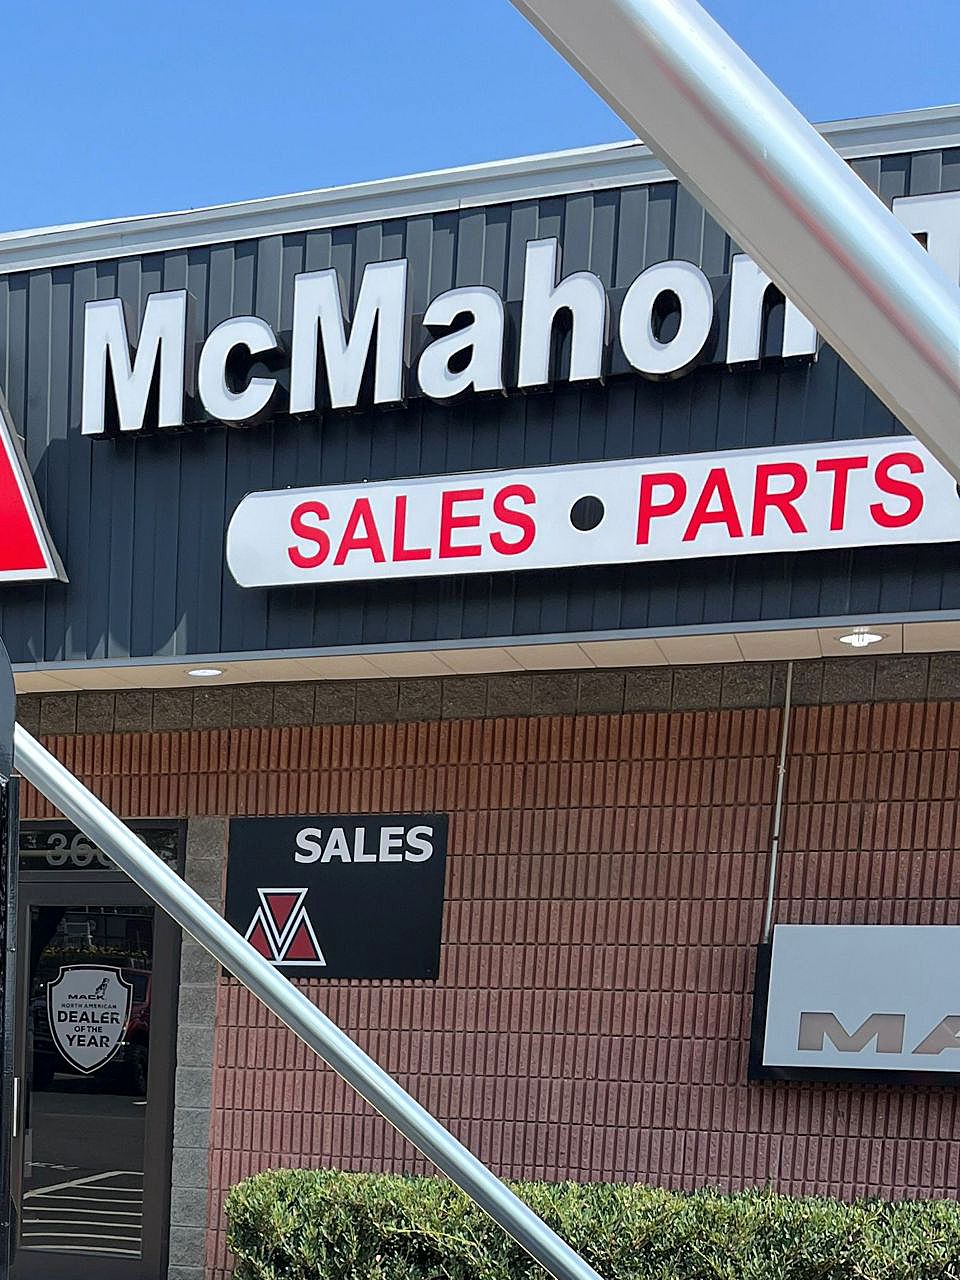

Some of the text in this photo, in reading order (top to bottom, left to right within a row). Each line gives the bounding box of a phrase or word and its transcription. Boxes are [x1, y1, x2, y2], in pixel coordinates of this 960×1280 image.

[81, 237, 819, 437] McMahon
[287, 451, 925, 569] SALES PARTS
[294, 825, 434, 864] SALES
[57, 1010, 120, 1024] DEALER
[74, 1025, 103, 1033] OF THE
[65, 1034, 110, 1048] YEAR
